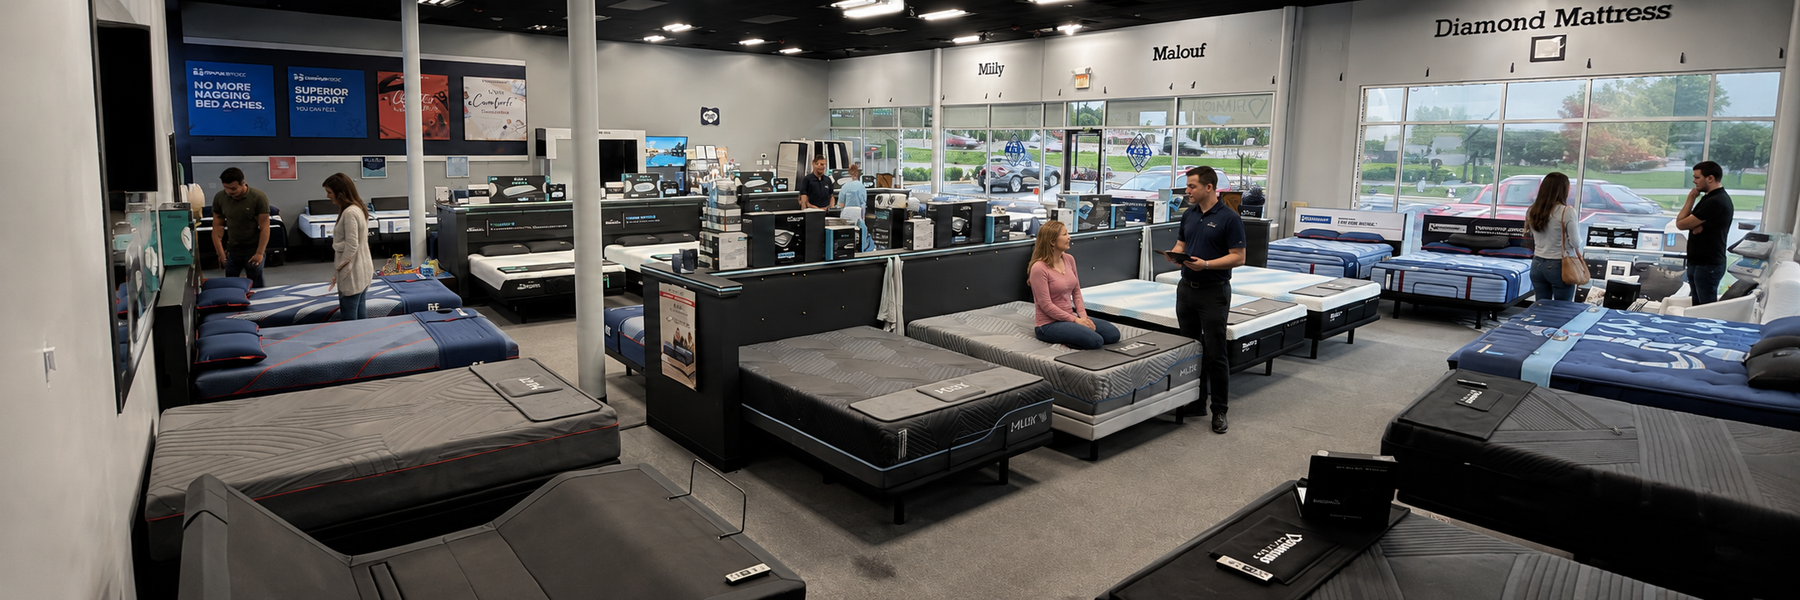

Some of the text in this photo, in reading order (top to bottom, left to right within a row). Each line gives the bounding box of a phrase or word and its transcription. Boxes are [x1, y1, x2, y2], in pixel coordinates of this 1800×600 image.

[1434, 4, 1673, 38] Diamond Mattress
[1152, 42, 1207, 61] Malouf
[194, 81, 251, 92] NO MORE
[294, 86, 349, 96] SUPERIOR
[194, 90, 251, 100] NAGGING
[295, 95, 346, 104] SUPPORT
[195, 100, 266, 110] BED ACHES.
